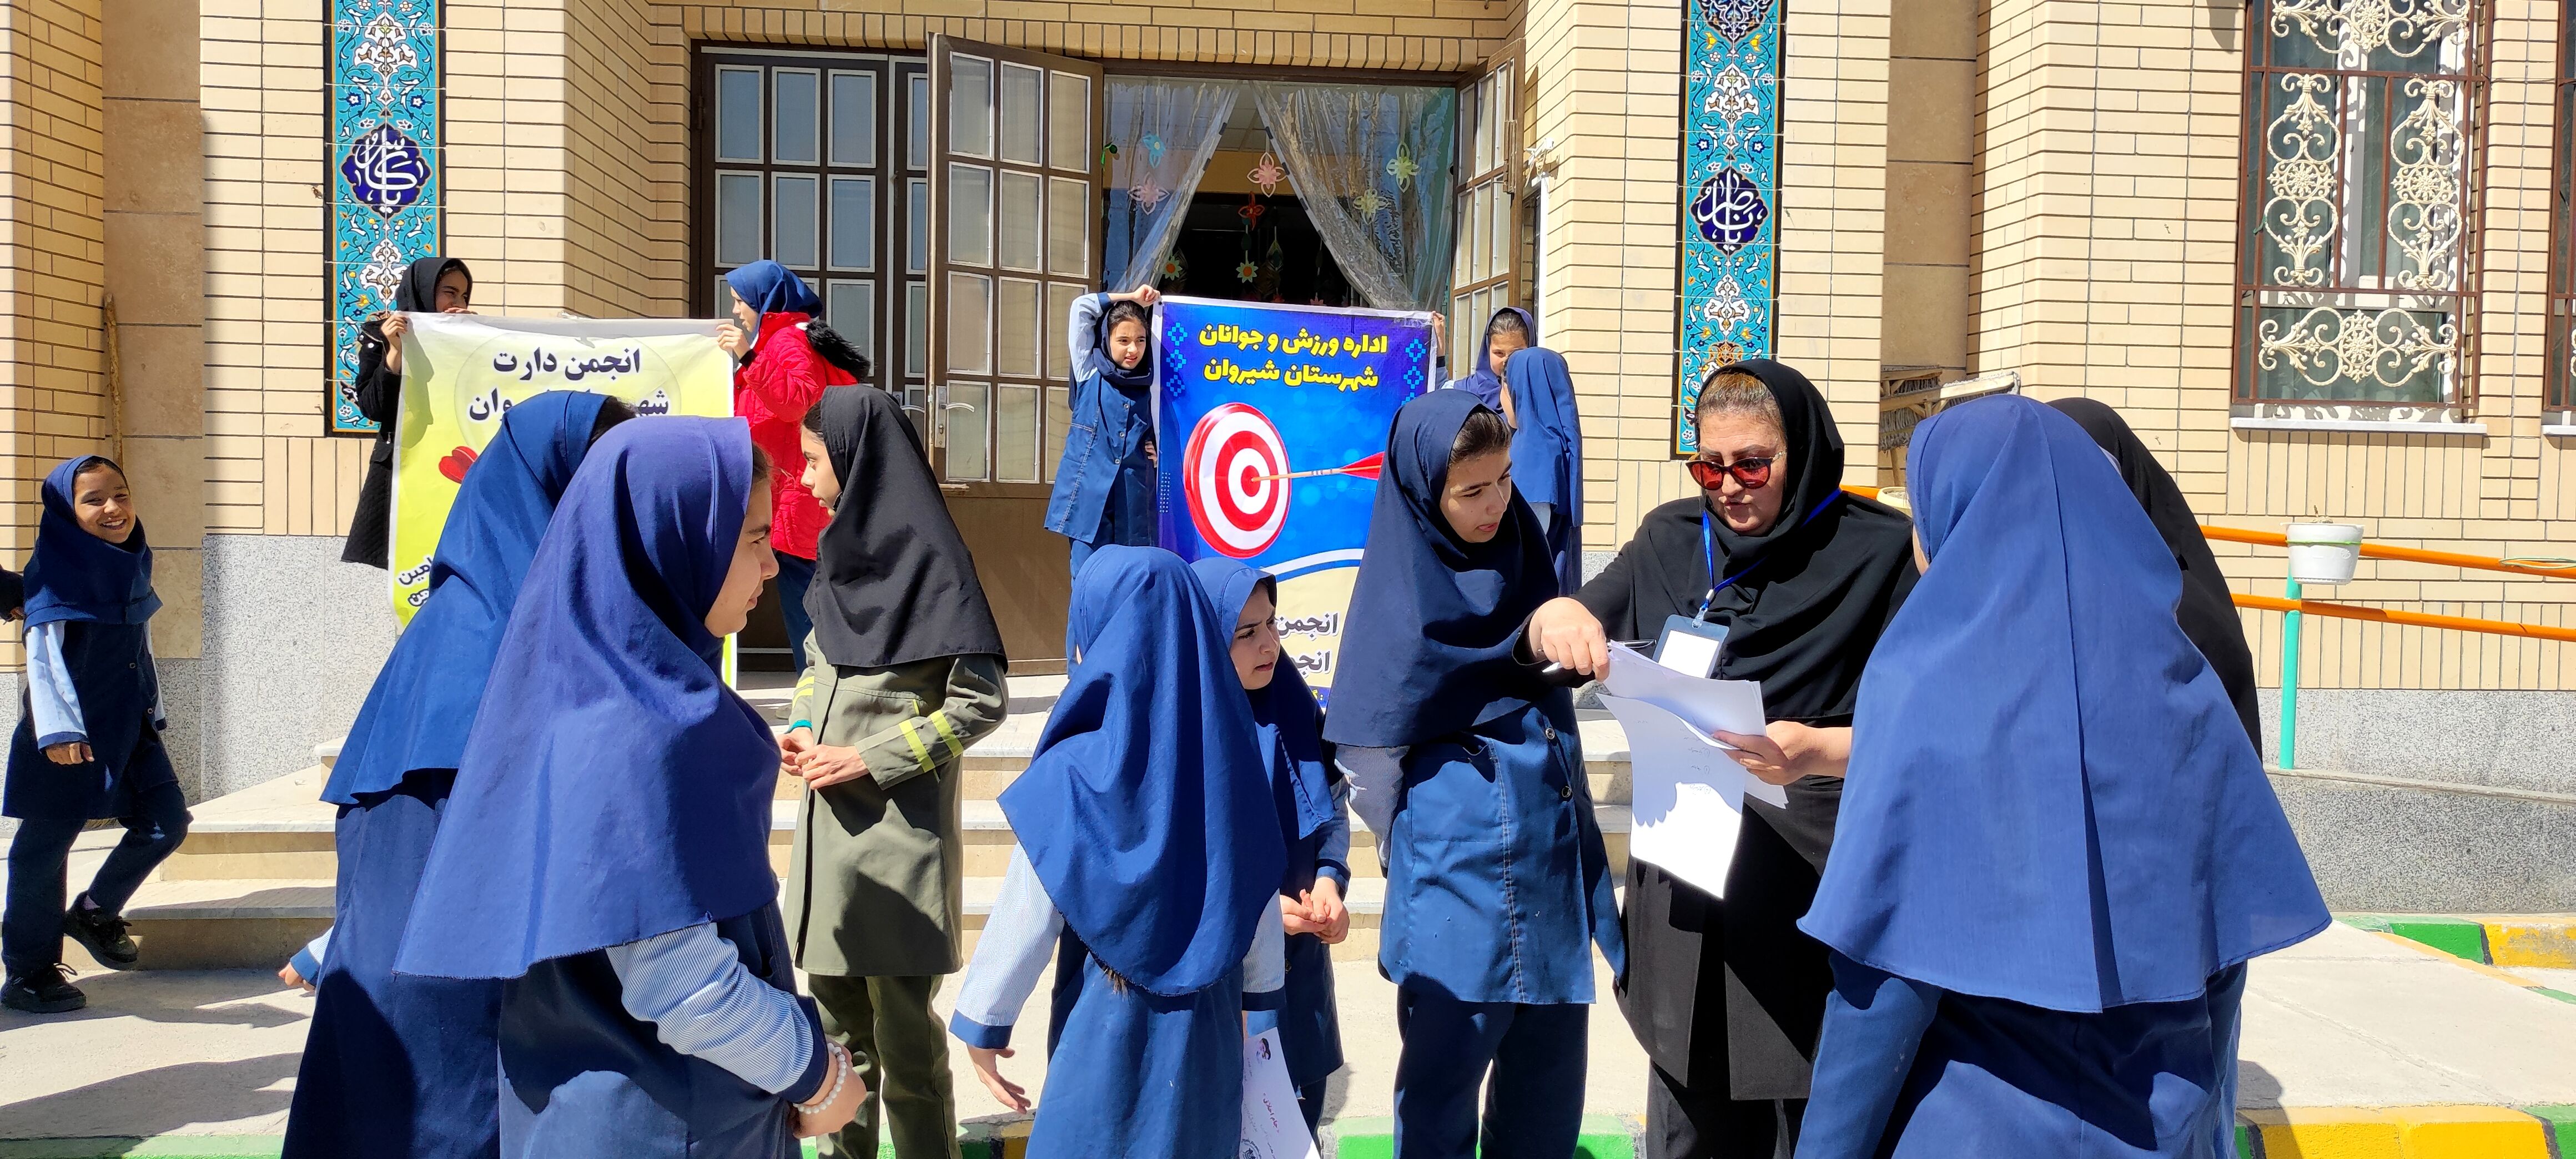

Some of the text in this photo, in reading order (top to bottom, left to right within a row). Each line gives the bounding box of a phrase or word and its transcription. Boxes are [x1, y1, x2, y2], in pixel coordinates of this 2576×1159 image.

[1199, 324, 1388, 359] اداره ورزش و جوانان
[493, 346, 640, 381] انجمن دارت
[1203, 358, 1379, 392] شهرستان شیروان
[1279, 612, 1338, 638] انجمن
[1290, 651, 1330, 676] انج
